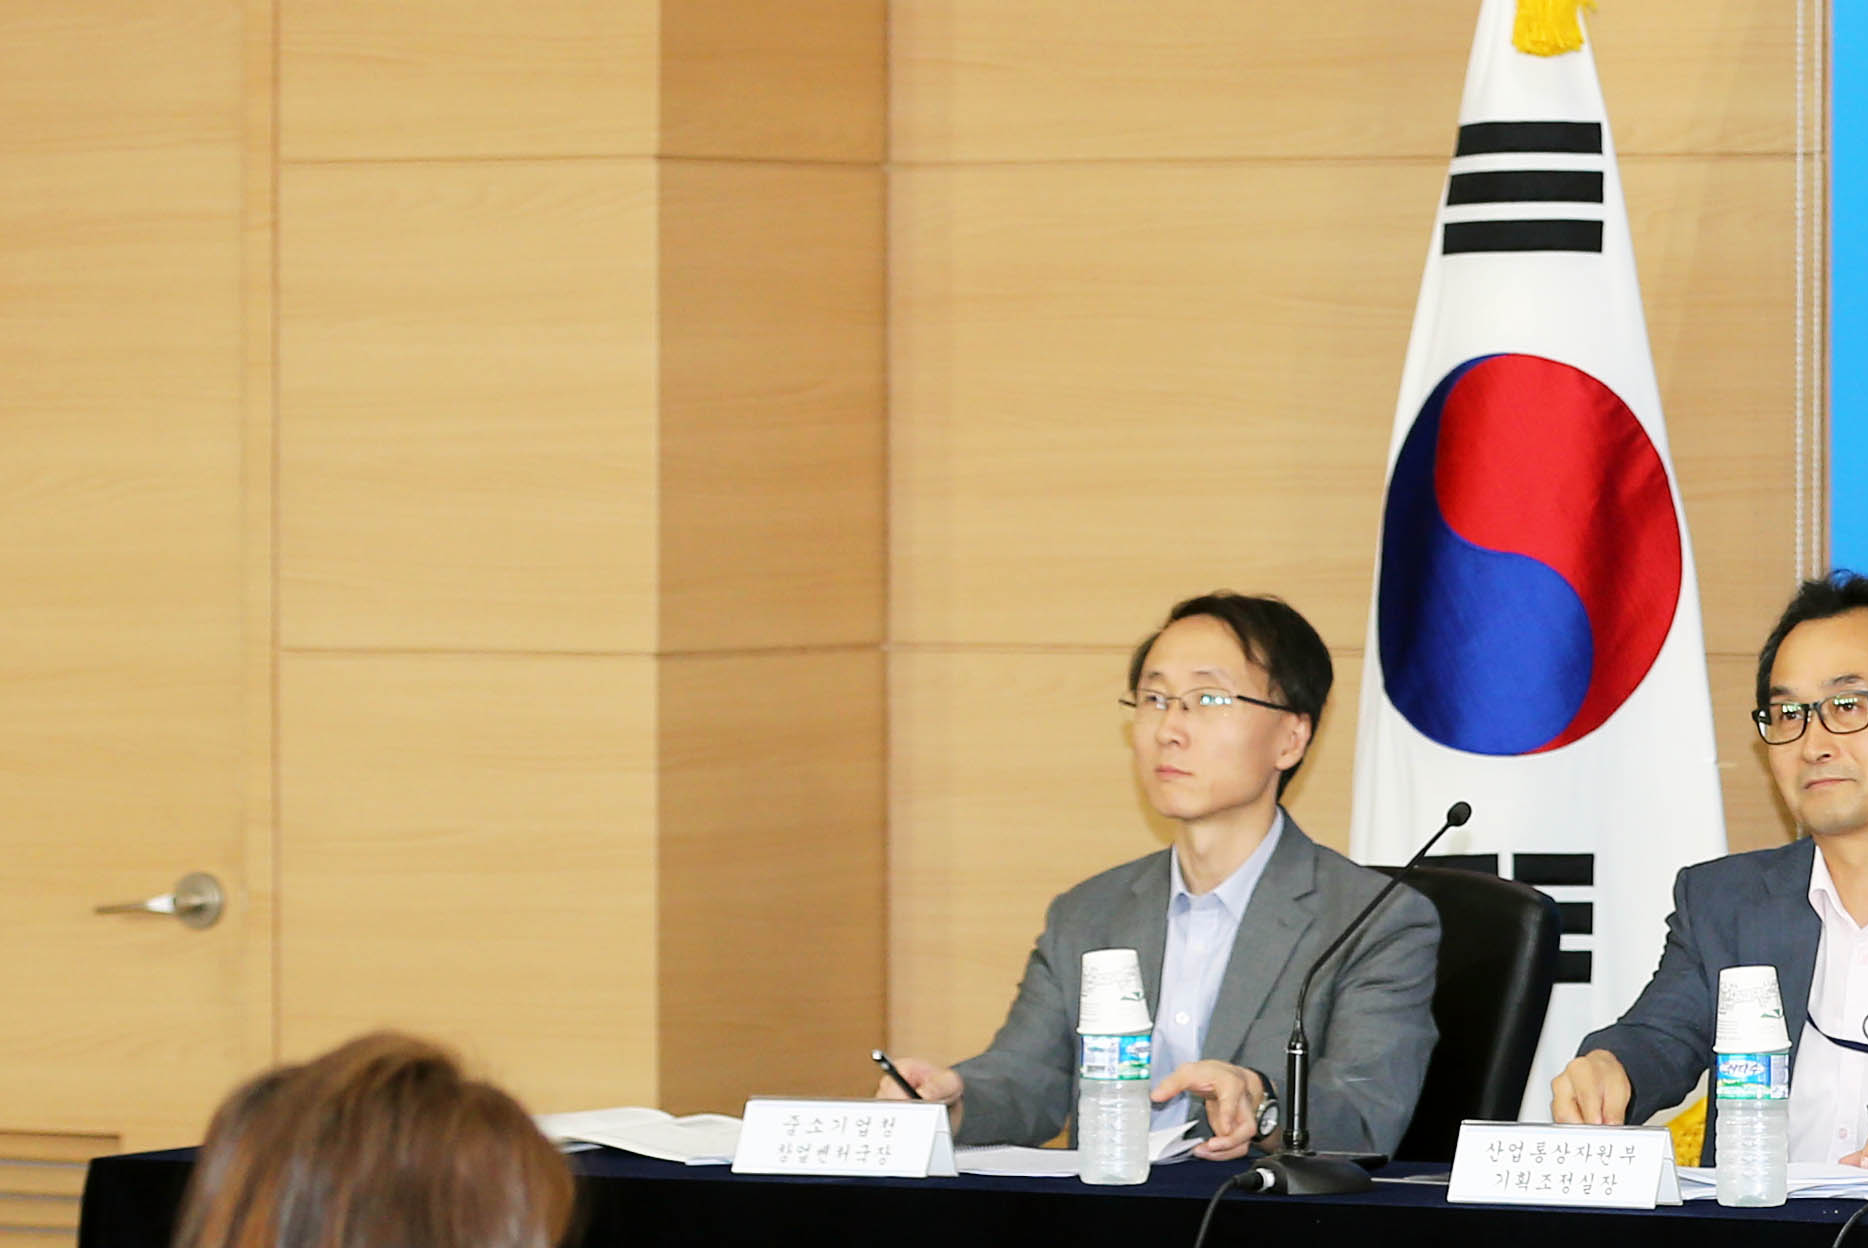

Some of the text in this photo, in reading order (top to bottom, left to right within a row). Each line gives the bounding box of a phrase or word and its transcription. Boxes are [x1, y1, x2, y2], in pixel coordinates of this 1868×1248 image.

[782, 1114, 896, 1138] 중소기업청
[1486, 1140, 1636, 1165] 산업통상자원부
[1496, 1170, 1618, 1196] 기획조정실장
